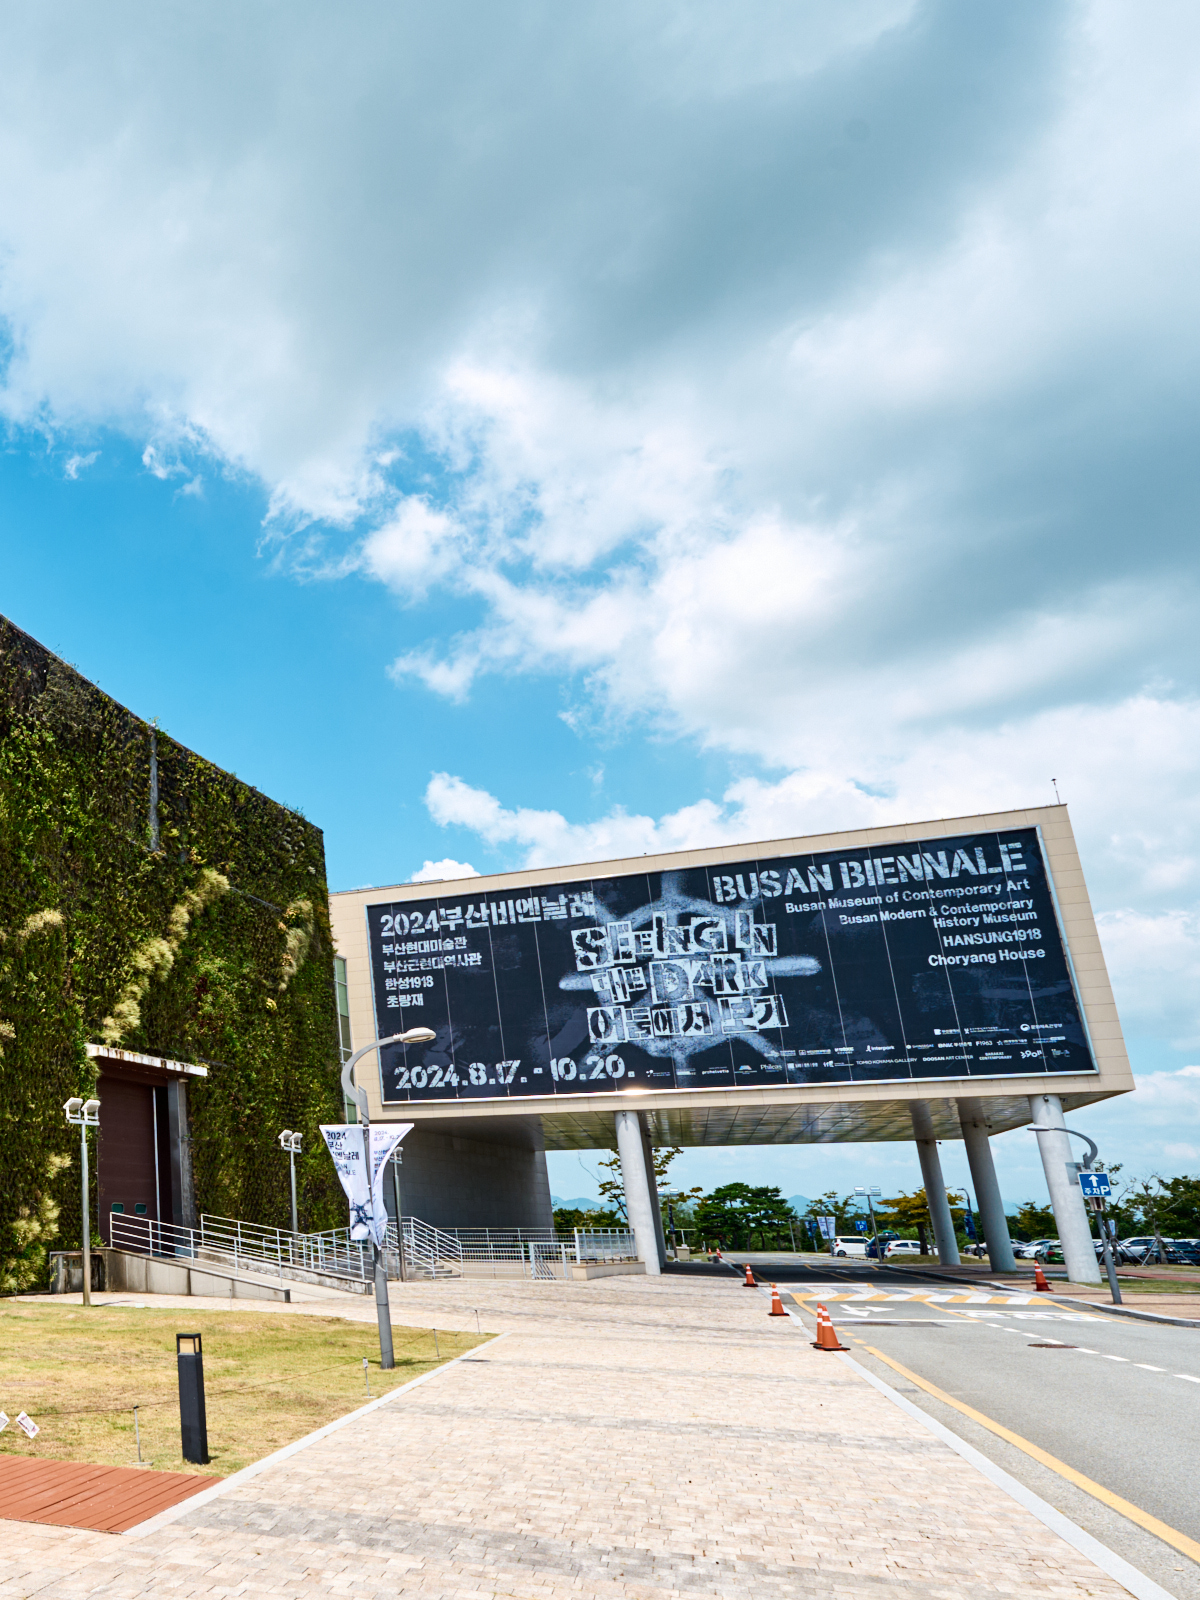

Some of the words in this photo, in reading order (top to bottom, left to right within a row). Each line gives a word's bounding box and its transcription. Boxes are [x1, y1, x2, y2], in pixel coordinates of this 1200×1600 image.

[712, 863, 835, 903] BUSAN
[838, 842, 1028, 890] BIENNALE
[785, 899, 827, 915] Busan
[828, 894, 883, 911] Museum
[885, 891, 900, 905] of
[902, 880, 1003, 903] Contemporary
[1006, 878, 1031, 892] Art
[380, 890, 596, 938] 2024부산비엔날레
[838, 911, 878, 926] Busan
[879, 907, 926, 923] Modern
[928, 905, 939, 918] &
[940, 898, 1034, 918] Contemporary
[933, 915, 981, 931] History
[983, 910, 1038, 926] Museum
[381, 935, 468, 957] 부산현대미술관
[571, 911, 729, 972] SEEING
[735, 909, 778, 957] IN
[943, 928, 1042, 948] HANSUNG1918
[383, 952, 483, 974] 부산근현대역사관
[928, 953, 998, 969] Choryang
[999, 947, 1046, 962] House
[384, 975, 435, 992] 한성1918
[590, 965, 648, 1004] THE
[649, 952, 769, 1005] DARK
[386, 992, 425, 1009] 초량재
[717, 993, 790, 1035] 보기
[393, 1059, 528, 1090] 2024.8.17.
[550, 1054, 636, 1082] 10.20.
[332, 1151, 360, 1161] 엔날레
